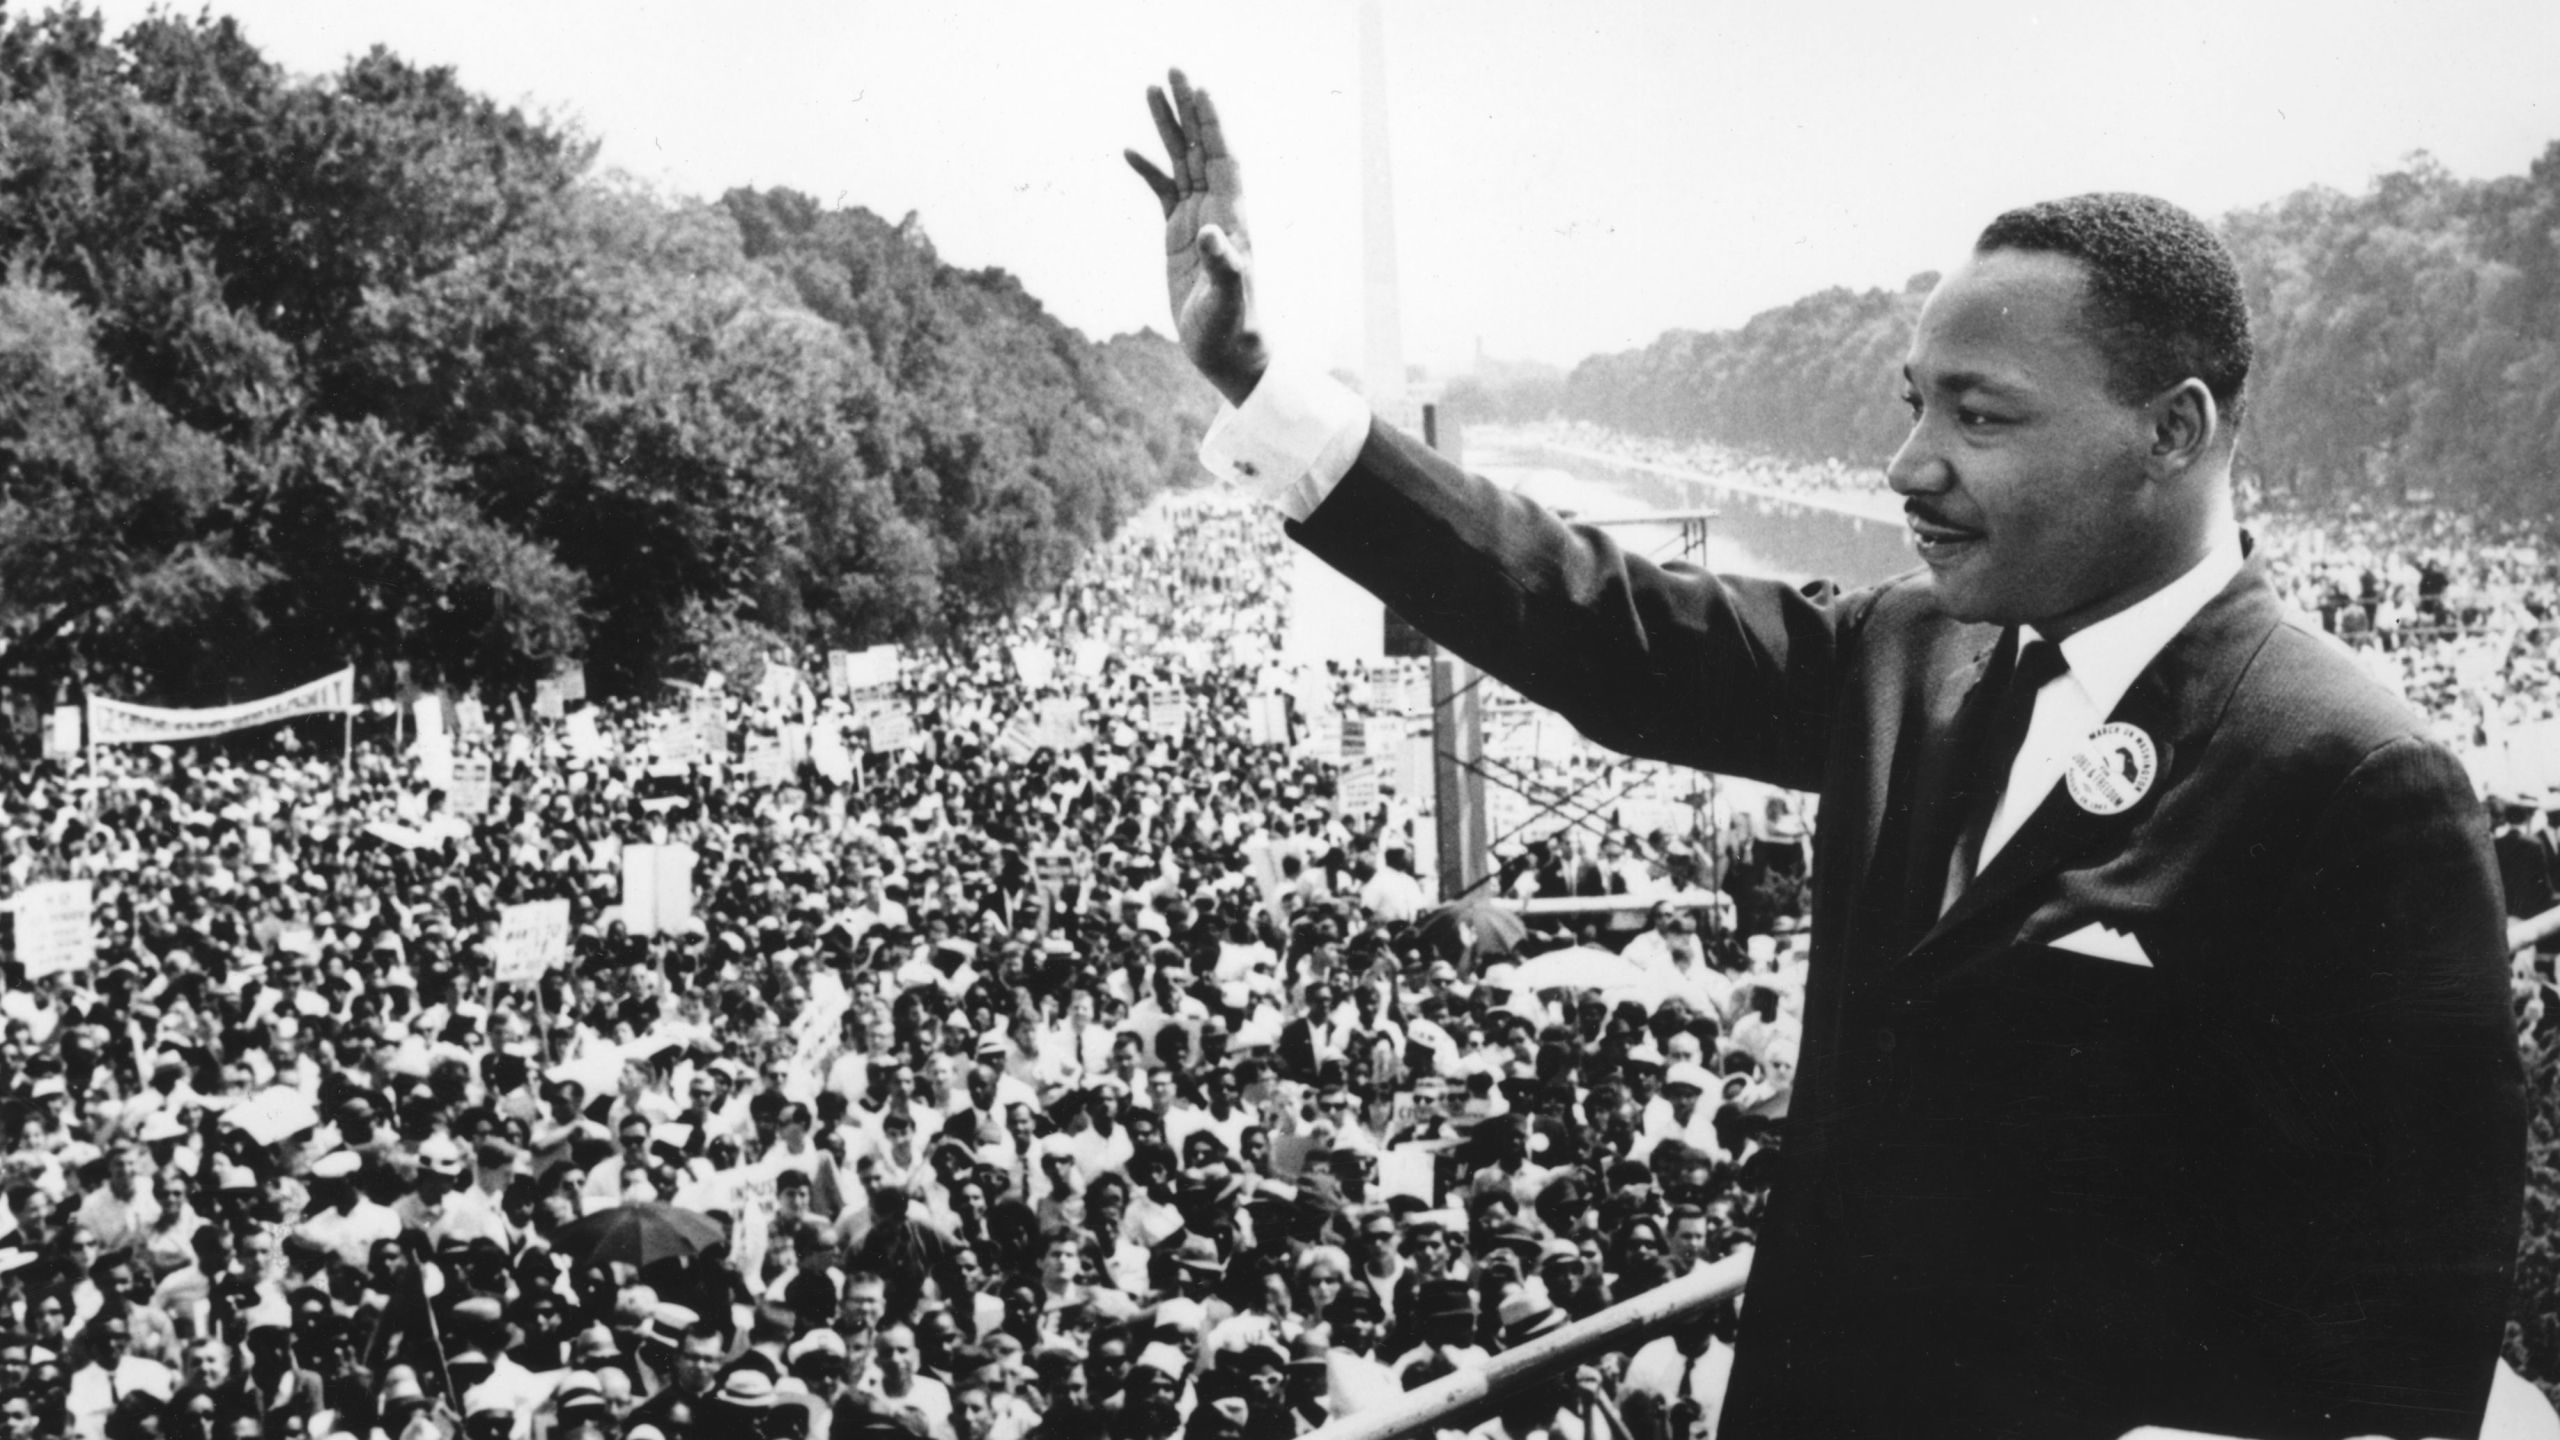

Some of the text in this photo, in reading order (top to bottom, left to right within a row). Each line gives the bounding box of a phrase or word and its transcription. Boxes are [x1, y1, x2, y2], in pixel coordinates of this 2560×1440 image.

[2089, 726, 2151, 792] MARCH ON WASHINGTON
[2094, 773, 2124, 807] FREEDOM
